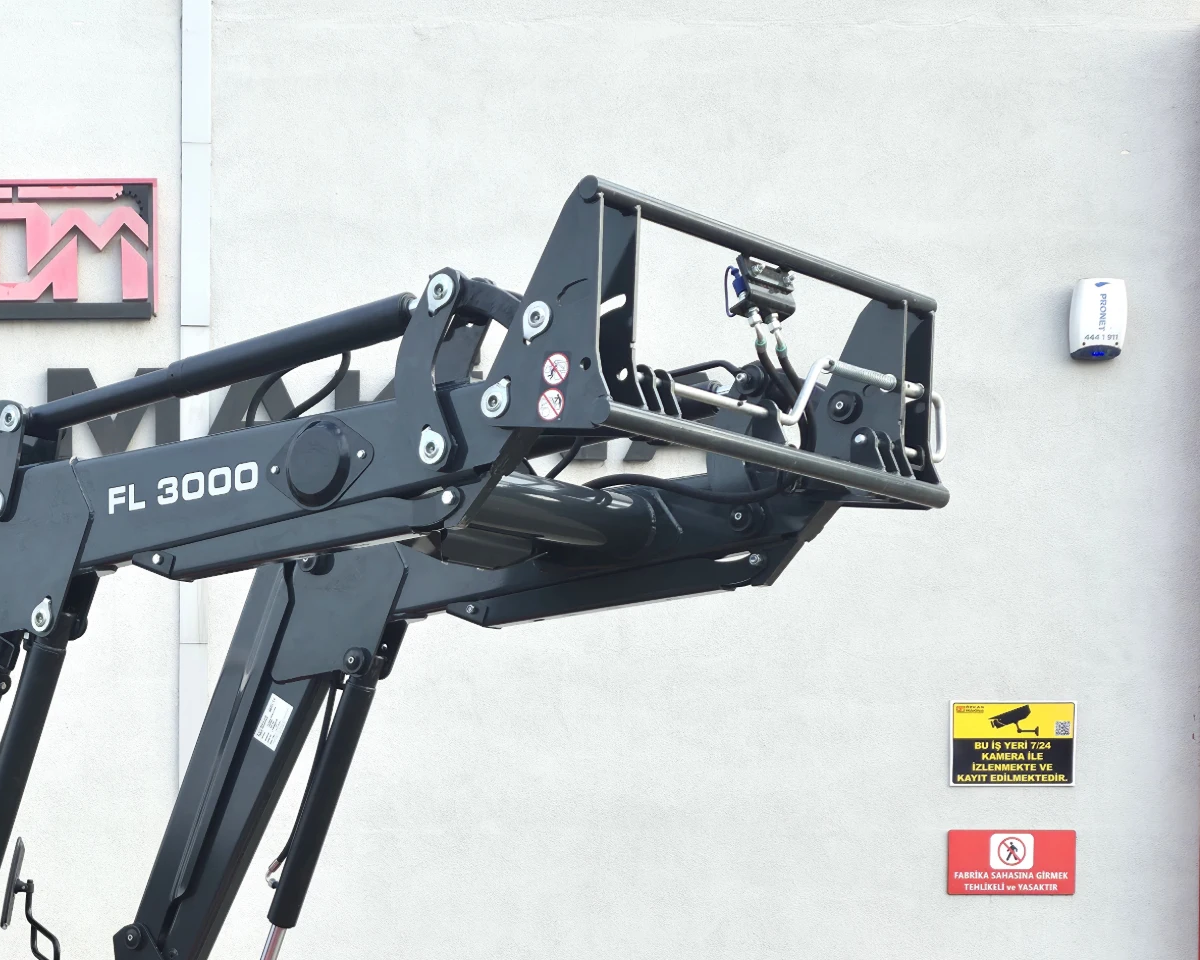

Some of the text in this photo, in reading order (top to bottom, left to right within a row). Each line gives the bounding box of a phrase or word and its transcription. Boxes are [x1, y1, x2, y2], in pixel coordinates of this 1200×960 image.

[1098, 293, 1107, 331] PRONET
[108, 461, 259, 515] FL 3000
[974, 740, 1052, 751] BU İŞ YERİ 7/24
[981, 751, 1044, 760] KAMERA İLE
[972, 762, 1053, 771] İZLENMEKTE VE
[957, 773, 1069, 782] KAYIT EDİLMEKTEDİR.
[954, 870, 1069, 880] FABRİKA SAHASINA GİRMEK
[964, 882, 1005, 891] TEHLİKELİ
[1018, 883, 1058, 891] YASAKTIR
